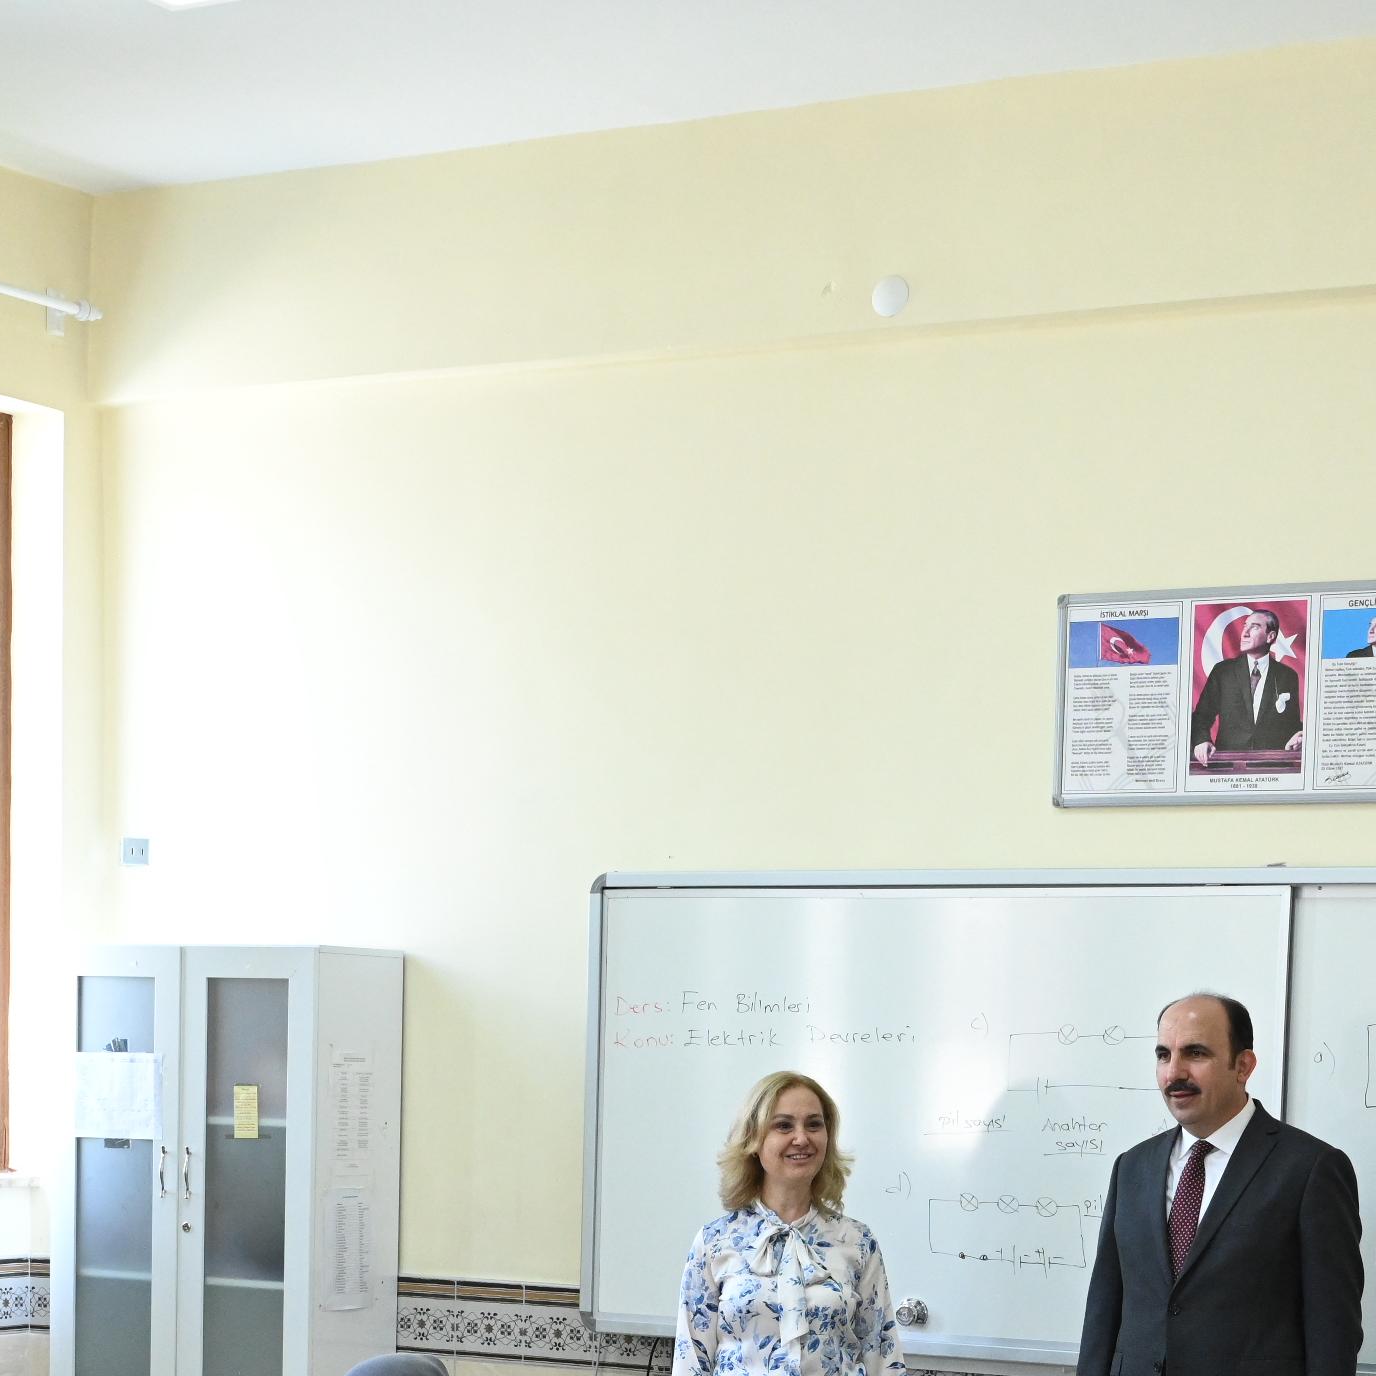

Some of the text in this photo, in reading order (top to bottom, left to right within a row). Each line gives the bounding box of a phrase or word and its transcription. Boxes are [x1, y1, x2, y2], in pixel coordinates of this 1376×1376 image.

[681, 990, 718, 1014] Fen
[684, 1027, 784, 1048] Elektrik
[806, 1024, 916, 1044] Devreleri
[1041, 1115, 1108, 1133] Anahtar
